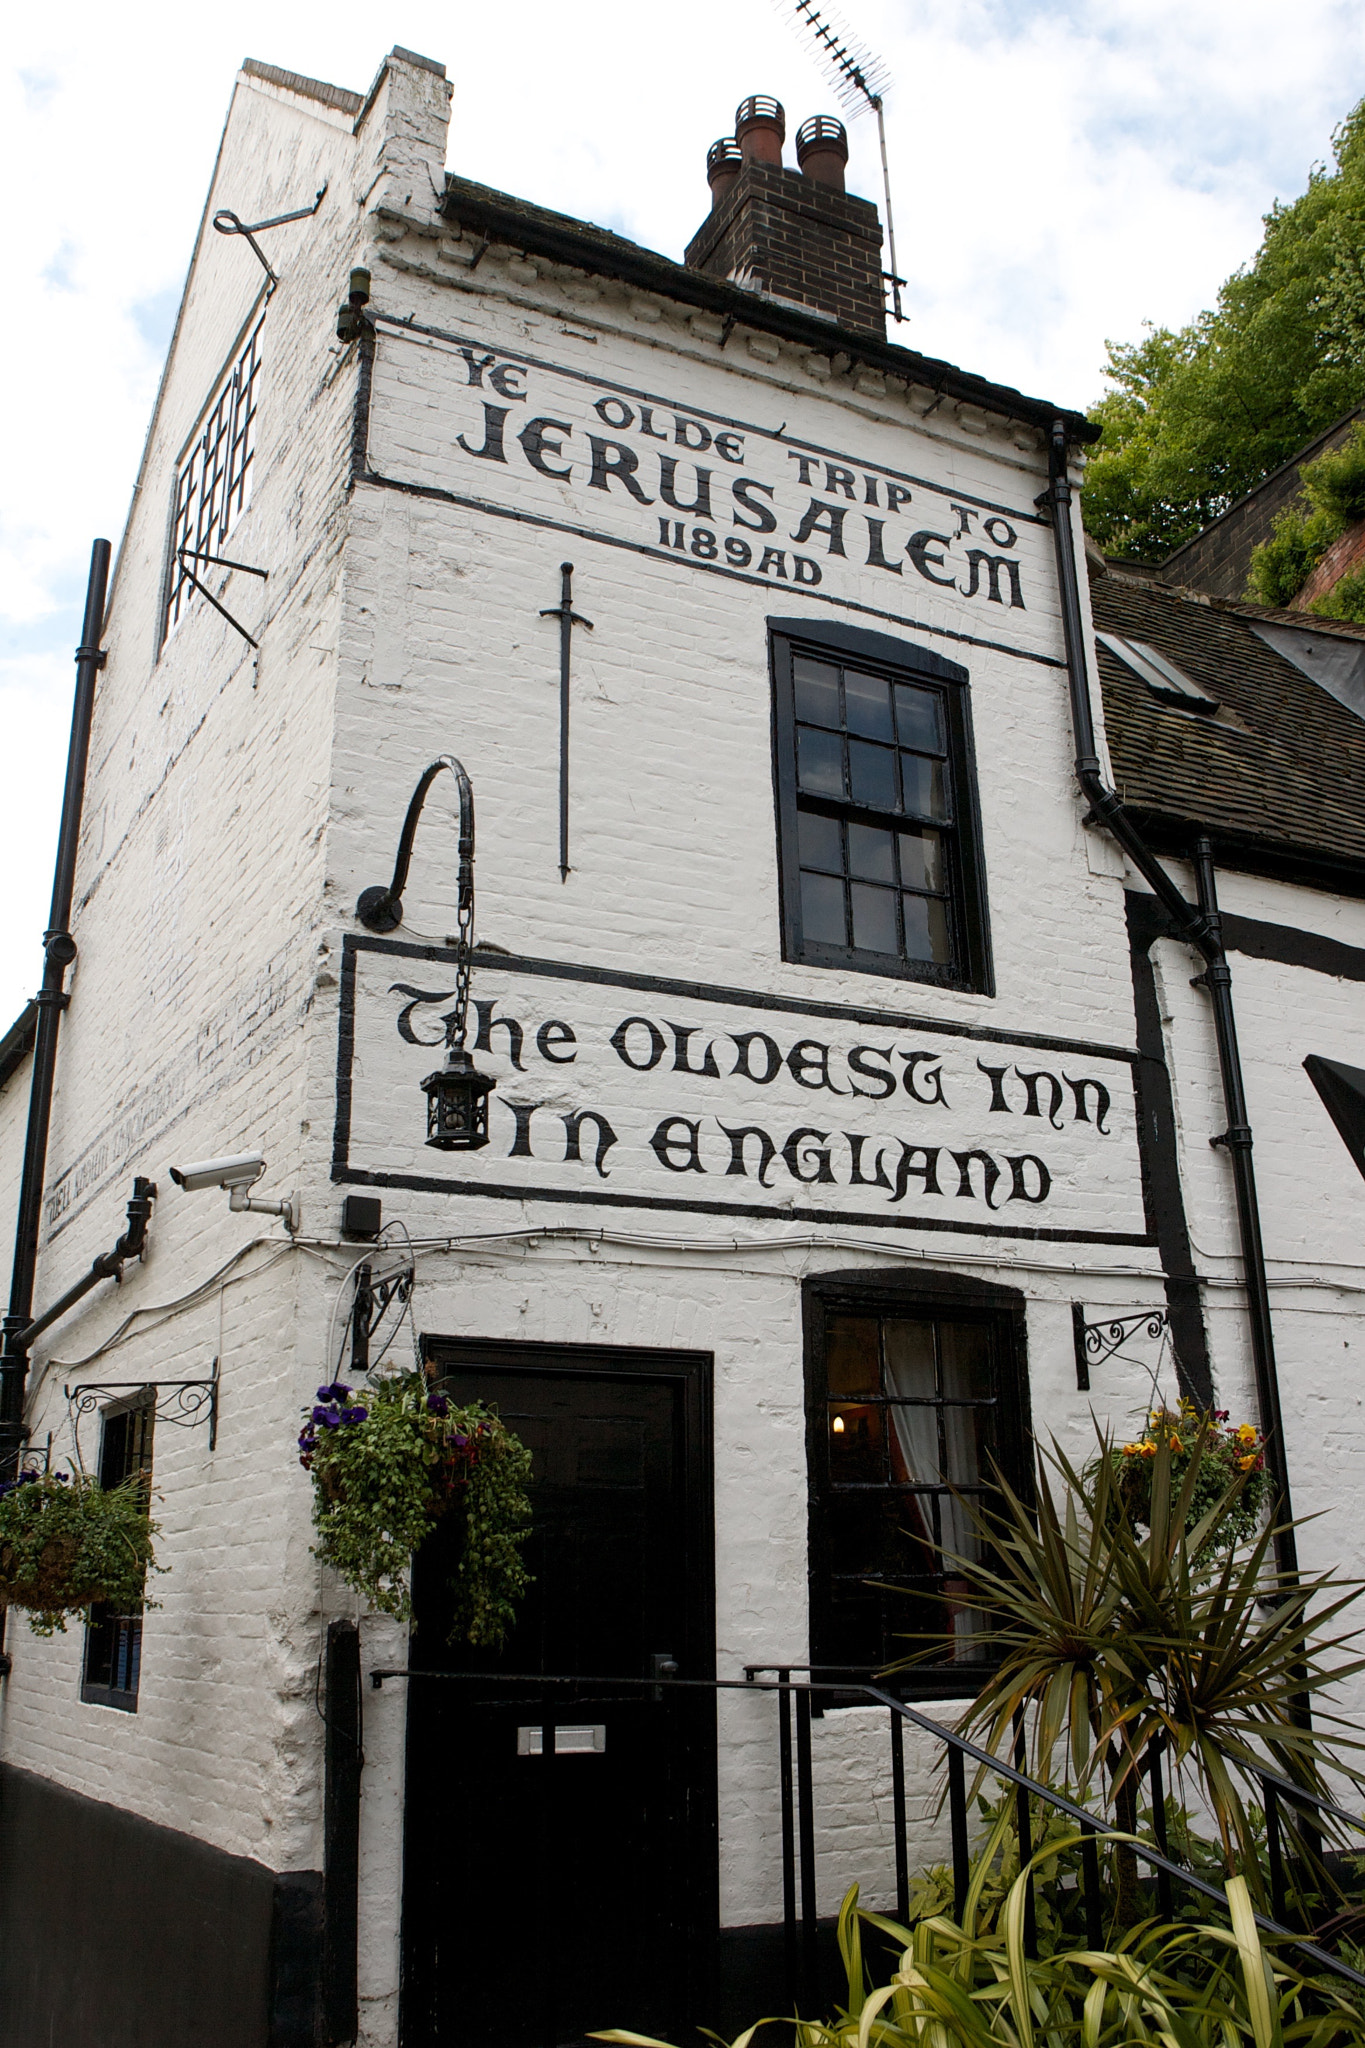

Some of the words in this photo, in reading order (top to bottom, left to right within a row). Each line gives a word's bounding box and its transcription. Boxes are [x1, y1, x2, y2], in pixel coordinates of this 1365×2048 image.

[455, 400, 1027, 611] JERUSALEM
[456, 347, 528, 402] YE
[592, 396, 746, 466] OLDE
[787, 450, 912, 514] TRIP
[950, 503, 1018, 549] TO
[608, 1016, 951, 1110] OLDEST
[649, 1115, 1054, 1210] ENGLAND
